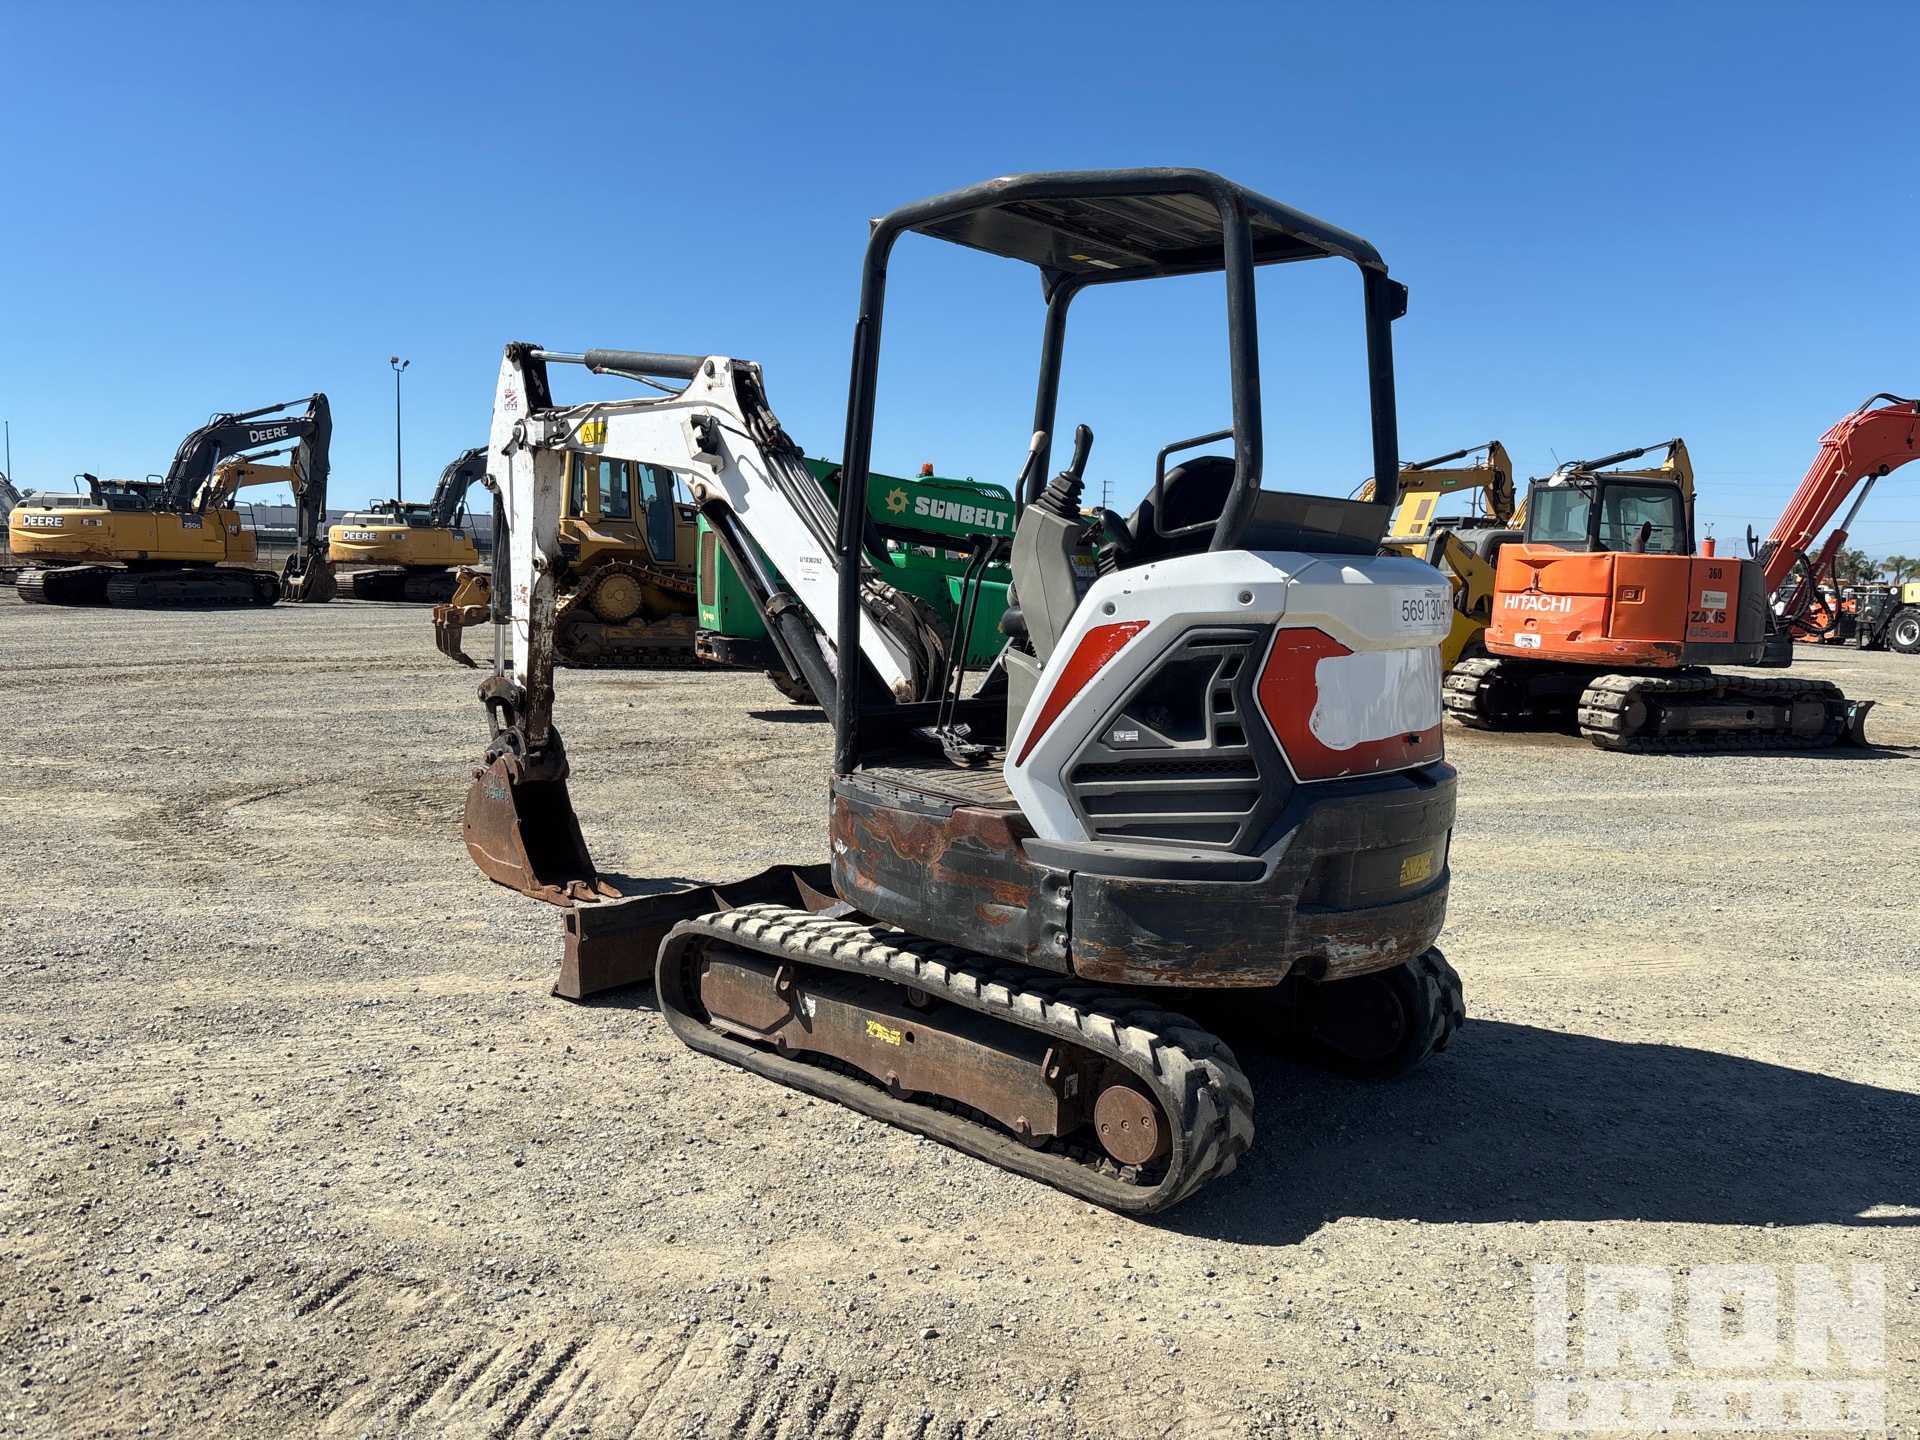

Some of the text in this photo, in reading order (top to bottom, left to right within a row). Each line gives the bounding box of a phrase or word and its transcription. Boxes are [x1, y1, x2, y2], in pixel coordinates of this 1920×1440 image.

[248, 425, 289, 444] DEERE
[22, 513, 64, 527] DEERE
[914, 495, 1009, 531] SUNBELT
[342, 530, 377, 540] DEERE
[1708, 567, 1723, 580] 360
[1503, 594, 1572, 613] HITACHI
[1690, 609, 1726, 624] ZAXIS
